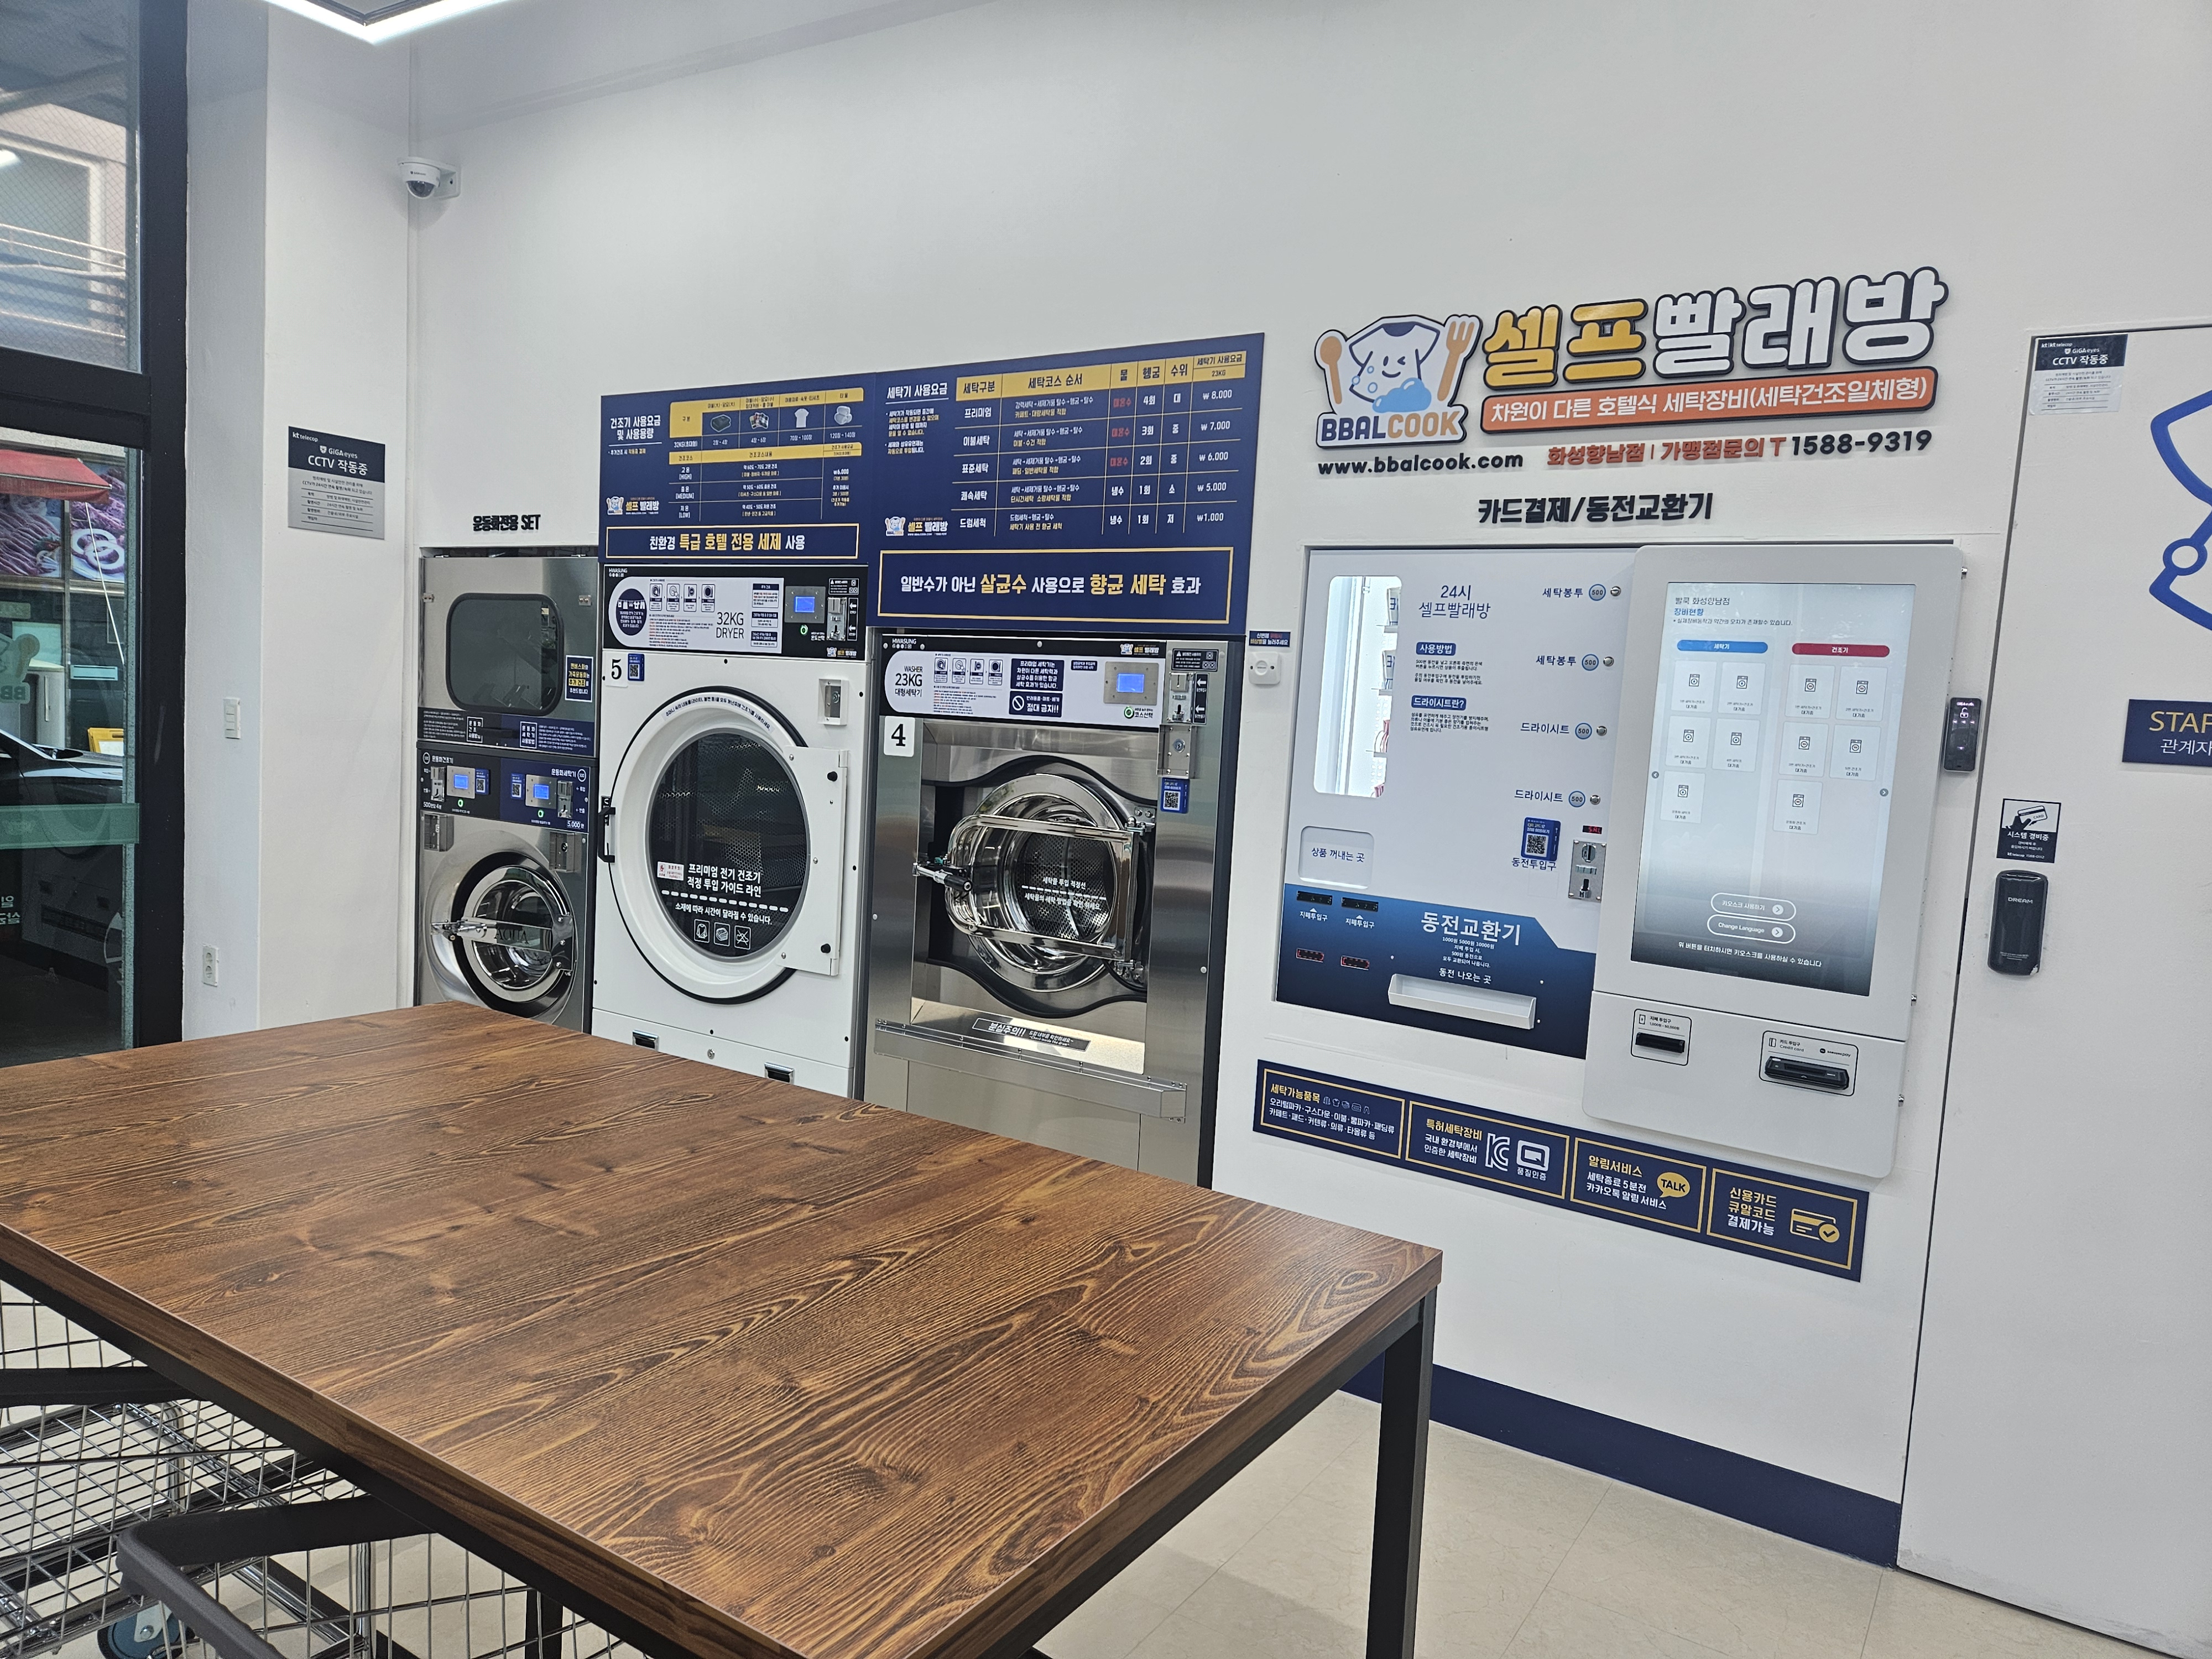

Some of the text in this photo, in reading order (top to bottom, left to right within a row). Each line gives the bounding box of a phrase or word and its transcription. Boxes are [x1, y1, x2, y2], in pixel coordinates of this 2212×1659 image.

[1197, 353, 1242, 365] 세탁기 사용요금
[2052, 354, 2108, 365] CCTV 작동중
[1171, 363, 1187, 376] 수위
[963, 380, 995, 393] 세탁구분
[1028, 373, 1082, 388] 세탁코스 순서
[886, 382, 947, 398] 세탁기 사용요금
[1491, 377, 1926, 422] 차원이 다른 호텔식 세탁장비(세탁건조일체형)
[964, 407, 991, 418] 프리미엄
[610, 415, 660, 429] 건조기 사용요금
[1321, 410, 1460, 442] BBALCOOK
[617, 427, 654, 440] 및 사용용량
[963, 435, 990, 446] 이불세탁
[1547, 430, 1932, 465] 화성향남점 가맹점문의 T 1588-9319
[308, 455, 367, 475] CCTV 작동중
[962, 463, 988, 473] 표준세탁
[1318, 452, 1523, 474] www.bbalcook.com
[1478, 492, 1713, 524] 카드결제/동전교환기
[472, 514, 541, 531] 운동화전용 SET
[959, 518, 985, 528] 드럼세척
[649, 533, 805, 550] 친환경 특급 호텔 전용 세제 사용
[901, 574, 1201, 594] 일반수가 아닌 살균수 사용으로 향균 세탁 효과
[1440, 585, 1471, 600] 24시
[1542, 587, 1583, 598] 세탁봉투
[1418, 602, 1491, 619] 셀프빨래방
[717, 612, 743, 625] 32KG
[716, 627, 744, 639] DRYER
[1420, 644, 1453, 654] 사용방법
[1536, 655, 1576, 666] 세탁봉투
[611, 659, 622, 680] 5
[895, 672, 922, 686] 23KG
[895, 688, 922, 697] 대형세탁기
[1027, 703, 1058, 713] 절대 금지!!
[1413, 697, 1464, 708] 드라이시트란?
[891, 723, 906, 747] 4
[1520, 722, 1569, 734] 드라이시트
[551, 768, 576, 778] 운동화세탁기
[1514, 789, 1563, 802] 드라이시트
[1311, 847, 1364, 862] 상품 꺼내는 곳
[1512, 858, 1557, 872] 동전투입구
[688, 863, 718, 878] 프리미엄
[720, 867, 735, 880] 전기
[737, 869, 761, 884] 건조기
[687, 876, 761, 898] 적정 투입 가이드 라인
[675, 902, 772, 925] 소재에 따라 시간이 달라질 수 있습니다.
[1300, 911, 1328, 922] 지폐투입구
[1345, 918, 1375, 929] 지폐투입구
[1421, 912, 1521, 946] 동전교환기
[1718, 922, 1764, 933] Change Language
[1704, 945, 1732, 954] 터치하시면
[1734, 949, 1762, 959] 키오스크를
[1764, 953, 1788, 962] 사용하실
[1797, 958, 1822, 967] 있습니다
[1439, 968, 1491, 984] 동전 나오는 곳
[1270, 1083, 1319, 1103] 세탁가능품목
[1426, 1118, 1482, 1140] 특허세탁장비
[1425, 1134, 1477, 1153] 국내 환경부에서
[1424, 1144, 1477, 1164] 인증한 세탁장비
[1589, 1155, 1642, 1177] 알림서비스
[1517, 1167, 1547, 1181] 품질인증
[1587, 1171, 1646, 1193] 세탁종료 5분전
[1661, 1178, 1686, 1193] TALK
[1587, 1182, 1666, 1209] 카카오톡 알림 서비스
[1730, 1187, 1776, 1207] 신용카드
[1728, 1201, 1775, 1221] 큐알코드
[1727, 1214, 1774, 1235] 결제가능
